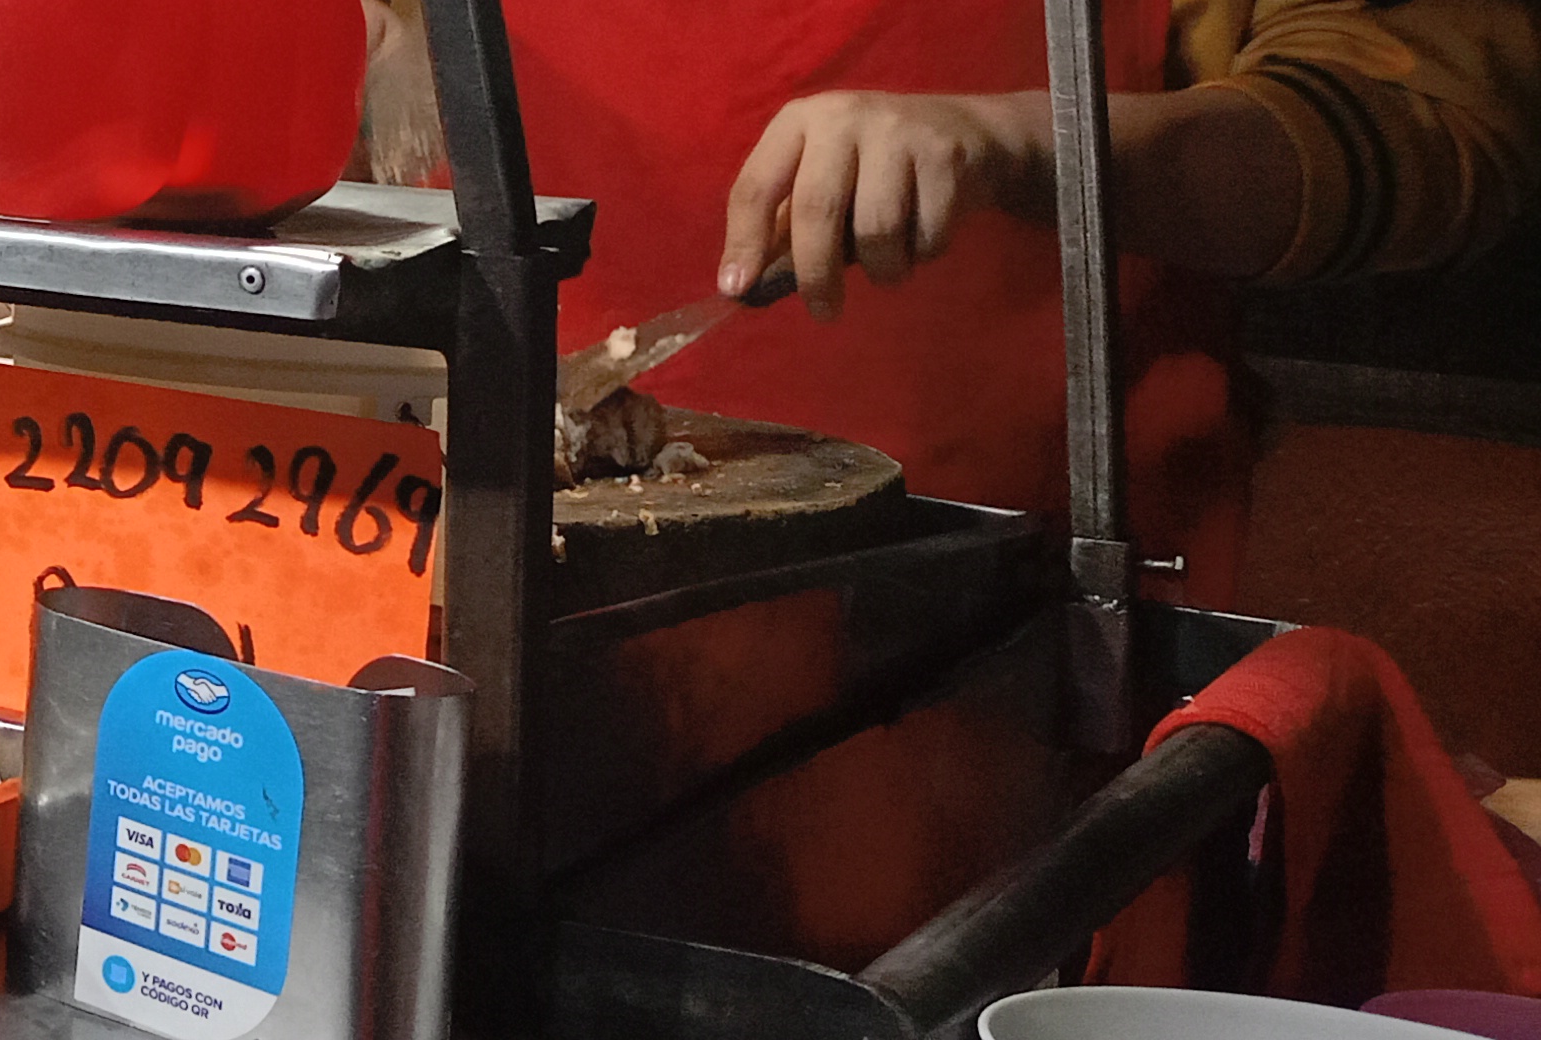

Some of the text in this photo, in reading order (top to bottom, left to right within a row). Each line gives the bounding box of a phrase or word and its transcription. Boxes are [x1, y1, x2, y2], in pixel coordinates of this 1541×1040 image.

[4, 412, 213, 511] 2209
[226, 444, 442, 577] 2969
[156, 710, 243, 748] mercado
[173, 735, 221, 762] pago
[107, 779, 282, 851] TODAS LAS TARJETAS
[142, 775, 246, 820] ACEPTAMOS
[126, 829, 154, 848] VISA
[140, 985, 210, 1020] CÓDIGO QR
[141, 970, 224, 1011] Y PAGOS CON
